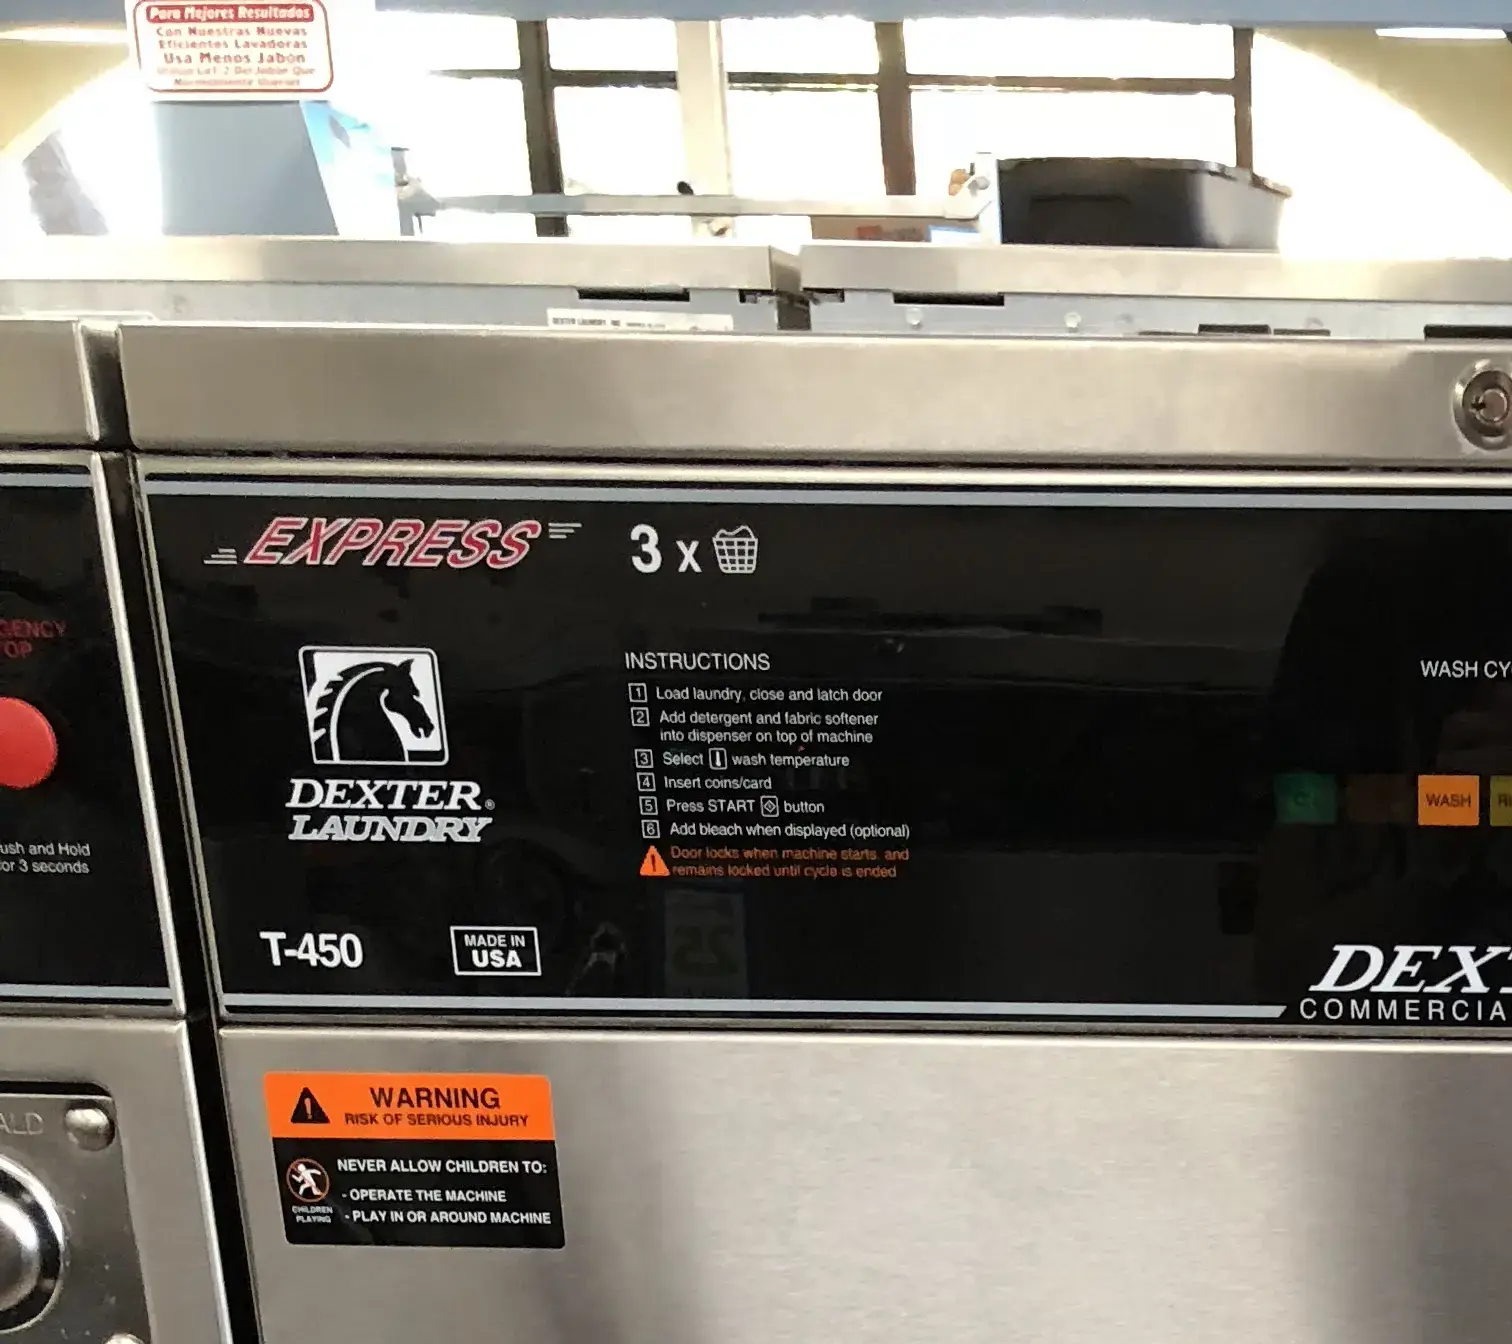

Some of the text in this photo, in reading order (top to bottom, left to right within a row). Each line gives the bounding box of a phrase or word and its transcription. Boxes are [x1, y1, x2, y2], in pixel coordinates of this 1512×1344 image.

[150, 7, 310, 21] Para Mejores Resultados
[156, 27, 307, 36] Con Nuestras Nuevas
[159, 40, 307, 49] Eficientes Lavadoras
[164, 53, 192, 64] Usa
[200, 53, 250, 63] Menos
[244, 517, 541, 568] EXPRESS
[630, 524, 702, 574] 3 x
[625, 653, 770, 671] INSTRUCTIONS
[1420, 660, 1478, 678] WASH
[656, 687, 689, 700] Load
[750, 688, 784, 701] close
[789, 688, 813, 701] and
[817, 689, 848, 701] latch
[853, 689, 883, 701] door
[660, 711, 878, 727] Add detergent and fabric softener
[660, 730, 873, 745] into dispenser on top of machine
[663, 753, 850, 768] Select wash temperature
[664, 777, 771, 790] Insert coins/card
[286, 778, 483, 811] DEXTER
[1425, 794, 1472, 808] WASH
[667, 800, 824, 813] Press START button
[288, 816, 493, 843] LAUNDRY
[670, 824, 910, 839] Add bleach when displayed (optional)
[0, 842, 90, 856] ush and Hold
[20, 859, 90, 873] 3 seconds
[464, 934, 526, 948] MADE IN
[260, 931, 364, 969] T-450
[472, 949, 522, 969] USA
[370, 1087, 500, 1109] WARNING
[344, 1114, 528, 1127] RISK OF SERIOUS INJURY
[337, 1159, 547, 1174] NEVER ALLOW CHILDREN TO:
[350, 1189, 506, 1202] OPERATE THE MACHINE
[292, 1206, 333, 1214] CHILDREN
[353, 1210, 551, 1224] PLAY IN OR AROUND MACHINE
[296, 1216, 331, 1224] PLAYING
